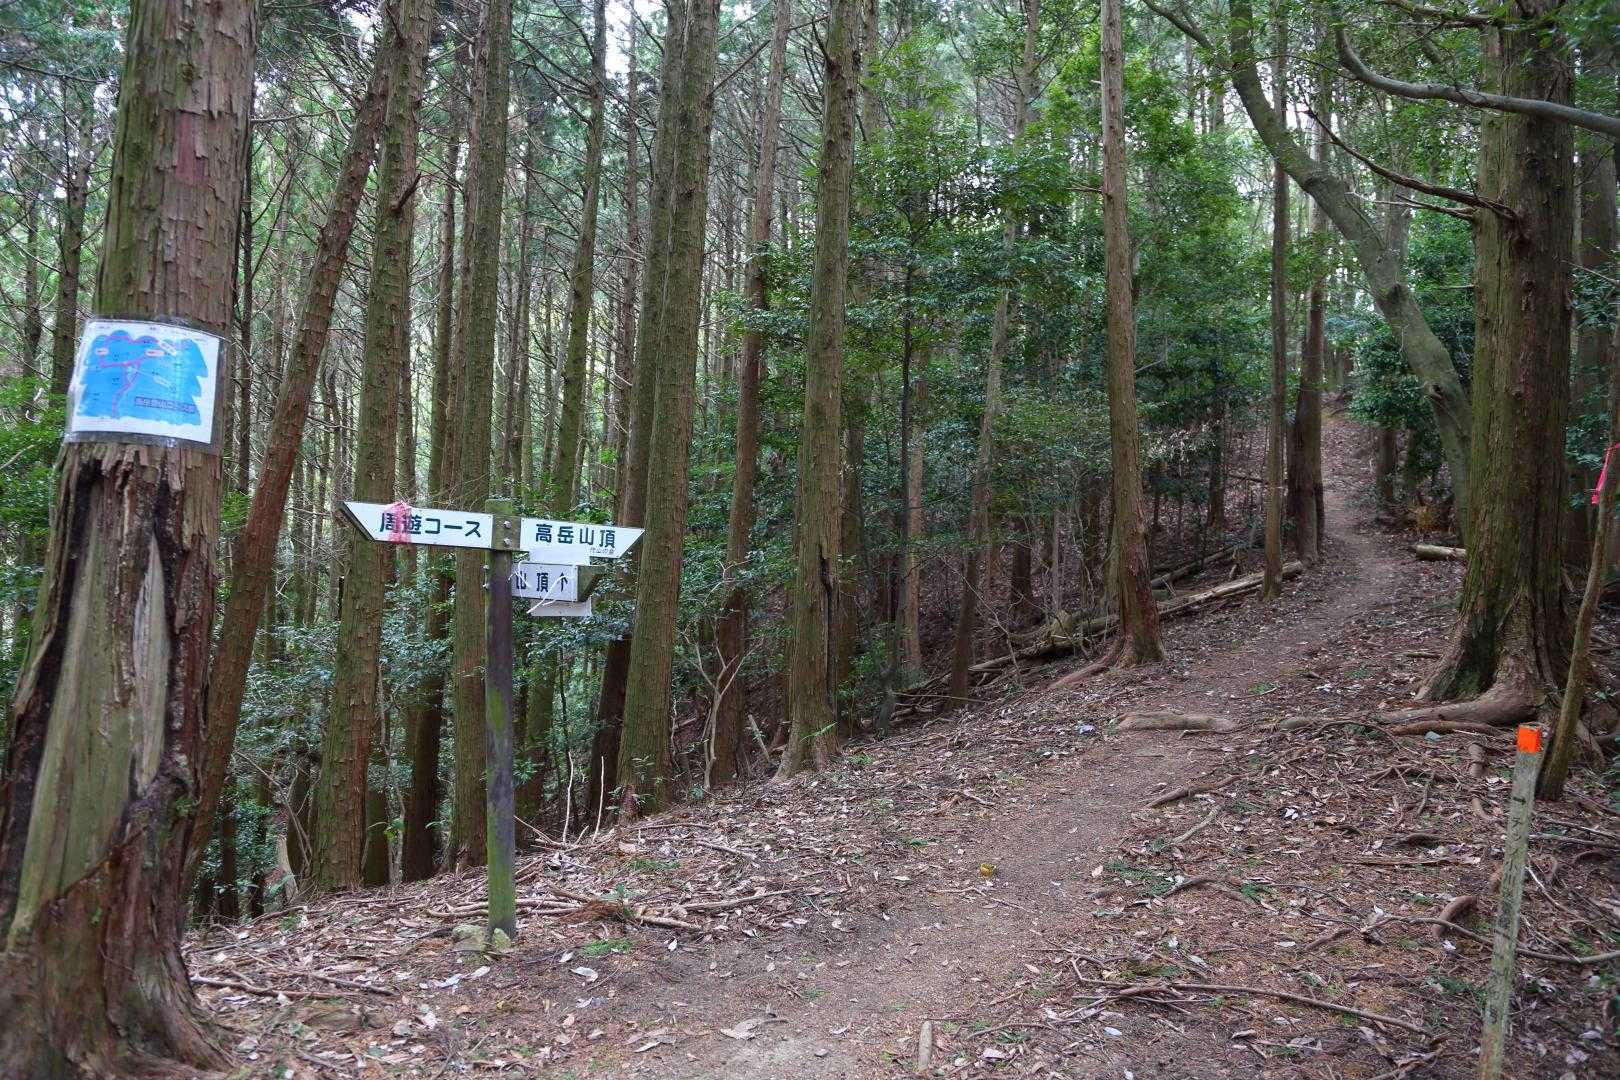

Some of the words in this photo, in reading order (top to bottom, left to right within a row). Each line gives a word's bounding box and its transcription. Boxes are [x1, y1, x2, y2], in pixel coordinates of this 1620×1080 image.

[380, 512, 481, 538] 周遊コース
[535, 523, 615, 549] 高岳山頂
[515, 571, 549, 593] 山頂
